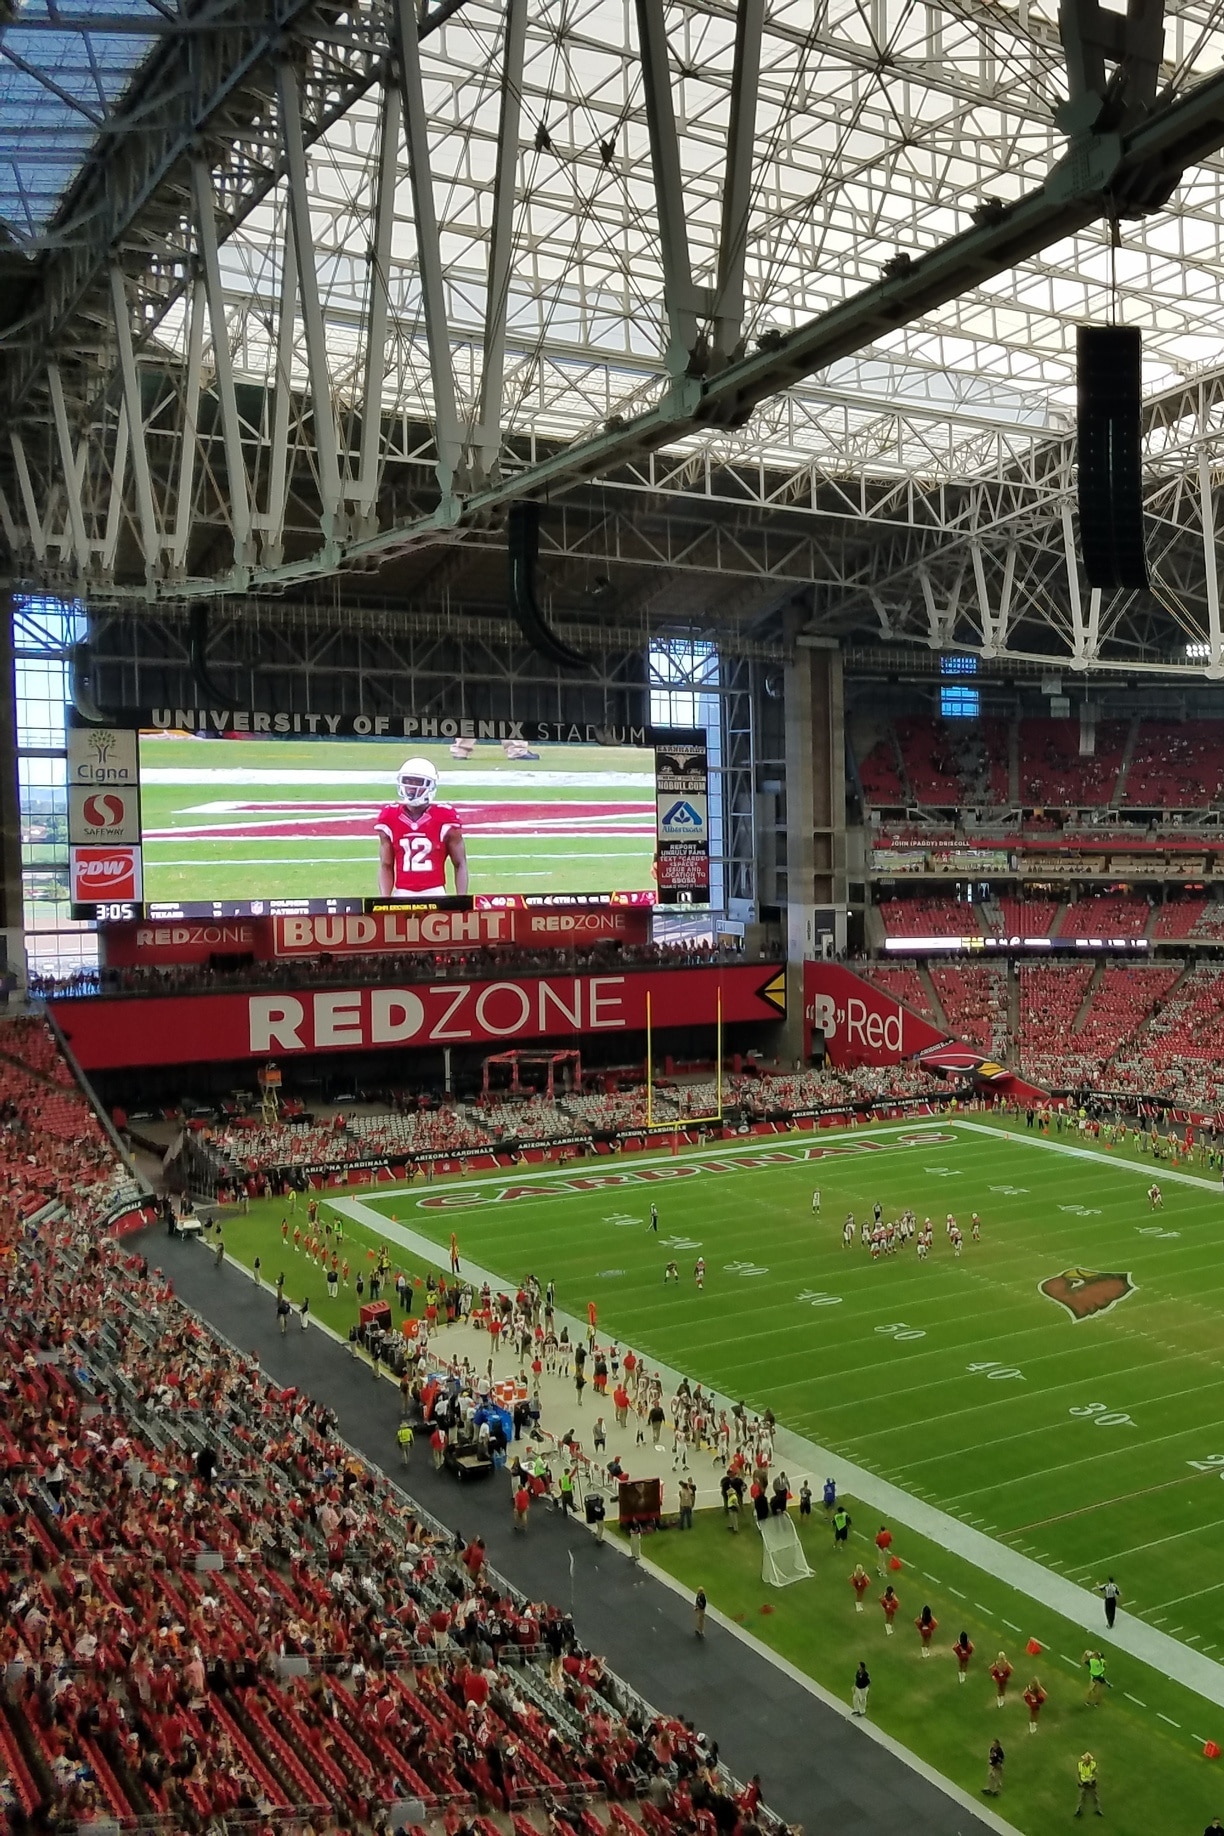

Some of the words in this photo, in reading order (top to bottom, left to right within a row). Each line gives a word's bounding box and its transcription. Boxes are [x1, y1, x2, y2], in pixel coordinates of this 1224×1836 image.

[151, 708, 342, 734] UNIVERSITY
[353, 715, 390, 735] OF
[403, 717, 524, 739] PHOENIX
[537, 722, 646, 744] STADUM
[77, 764, 129, 781] Cigna
[83, 828, 125, 836] SAFEWAY
[399, 837, 433, 872] 12
[76, 860, 126, 876] CDW
[96, 903, 134, 920] 3:05
[283, 916, 377, 948] BUD
[383, 911, 507, 943] LIGHT
[531, 914, 626, 932] REDZONE
[136, 926, 253, 948] REDZONE
[248, 976, 627, 1051] REDZONE
[847, 998, 903, 1052] Red
[791, 1110, 819, 1118] ARIZONA
[517, 1140, 550, 1150] ARIZONA
[552, 1135, 593, 1146] CARDINALS
[616, 1129, 647, 1139] ARIZONA
[343, 1158, 389, 1170] CARDINALS
[414, 1152, 450, 1162] ARIZONA
[451, 1147, 494, 1158] CARDINALS
[416, 1132, 960, 1210] CARDINALS
[873, 1321, 927, 1341] 50
[966, 1360, 1022, 1381] 40
[1068, 1402, 1131, 1427] 30
